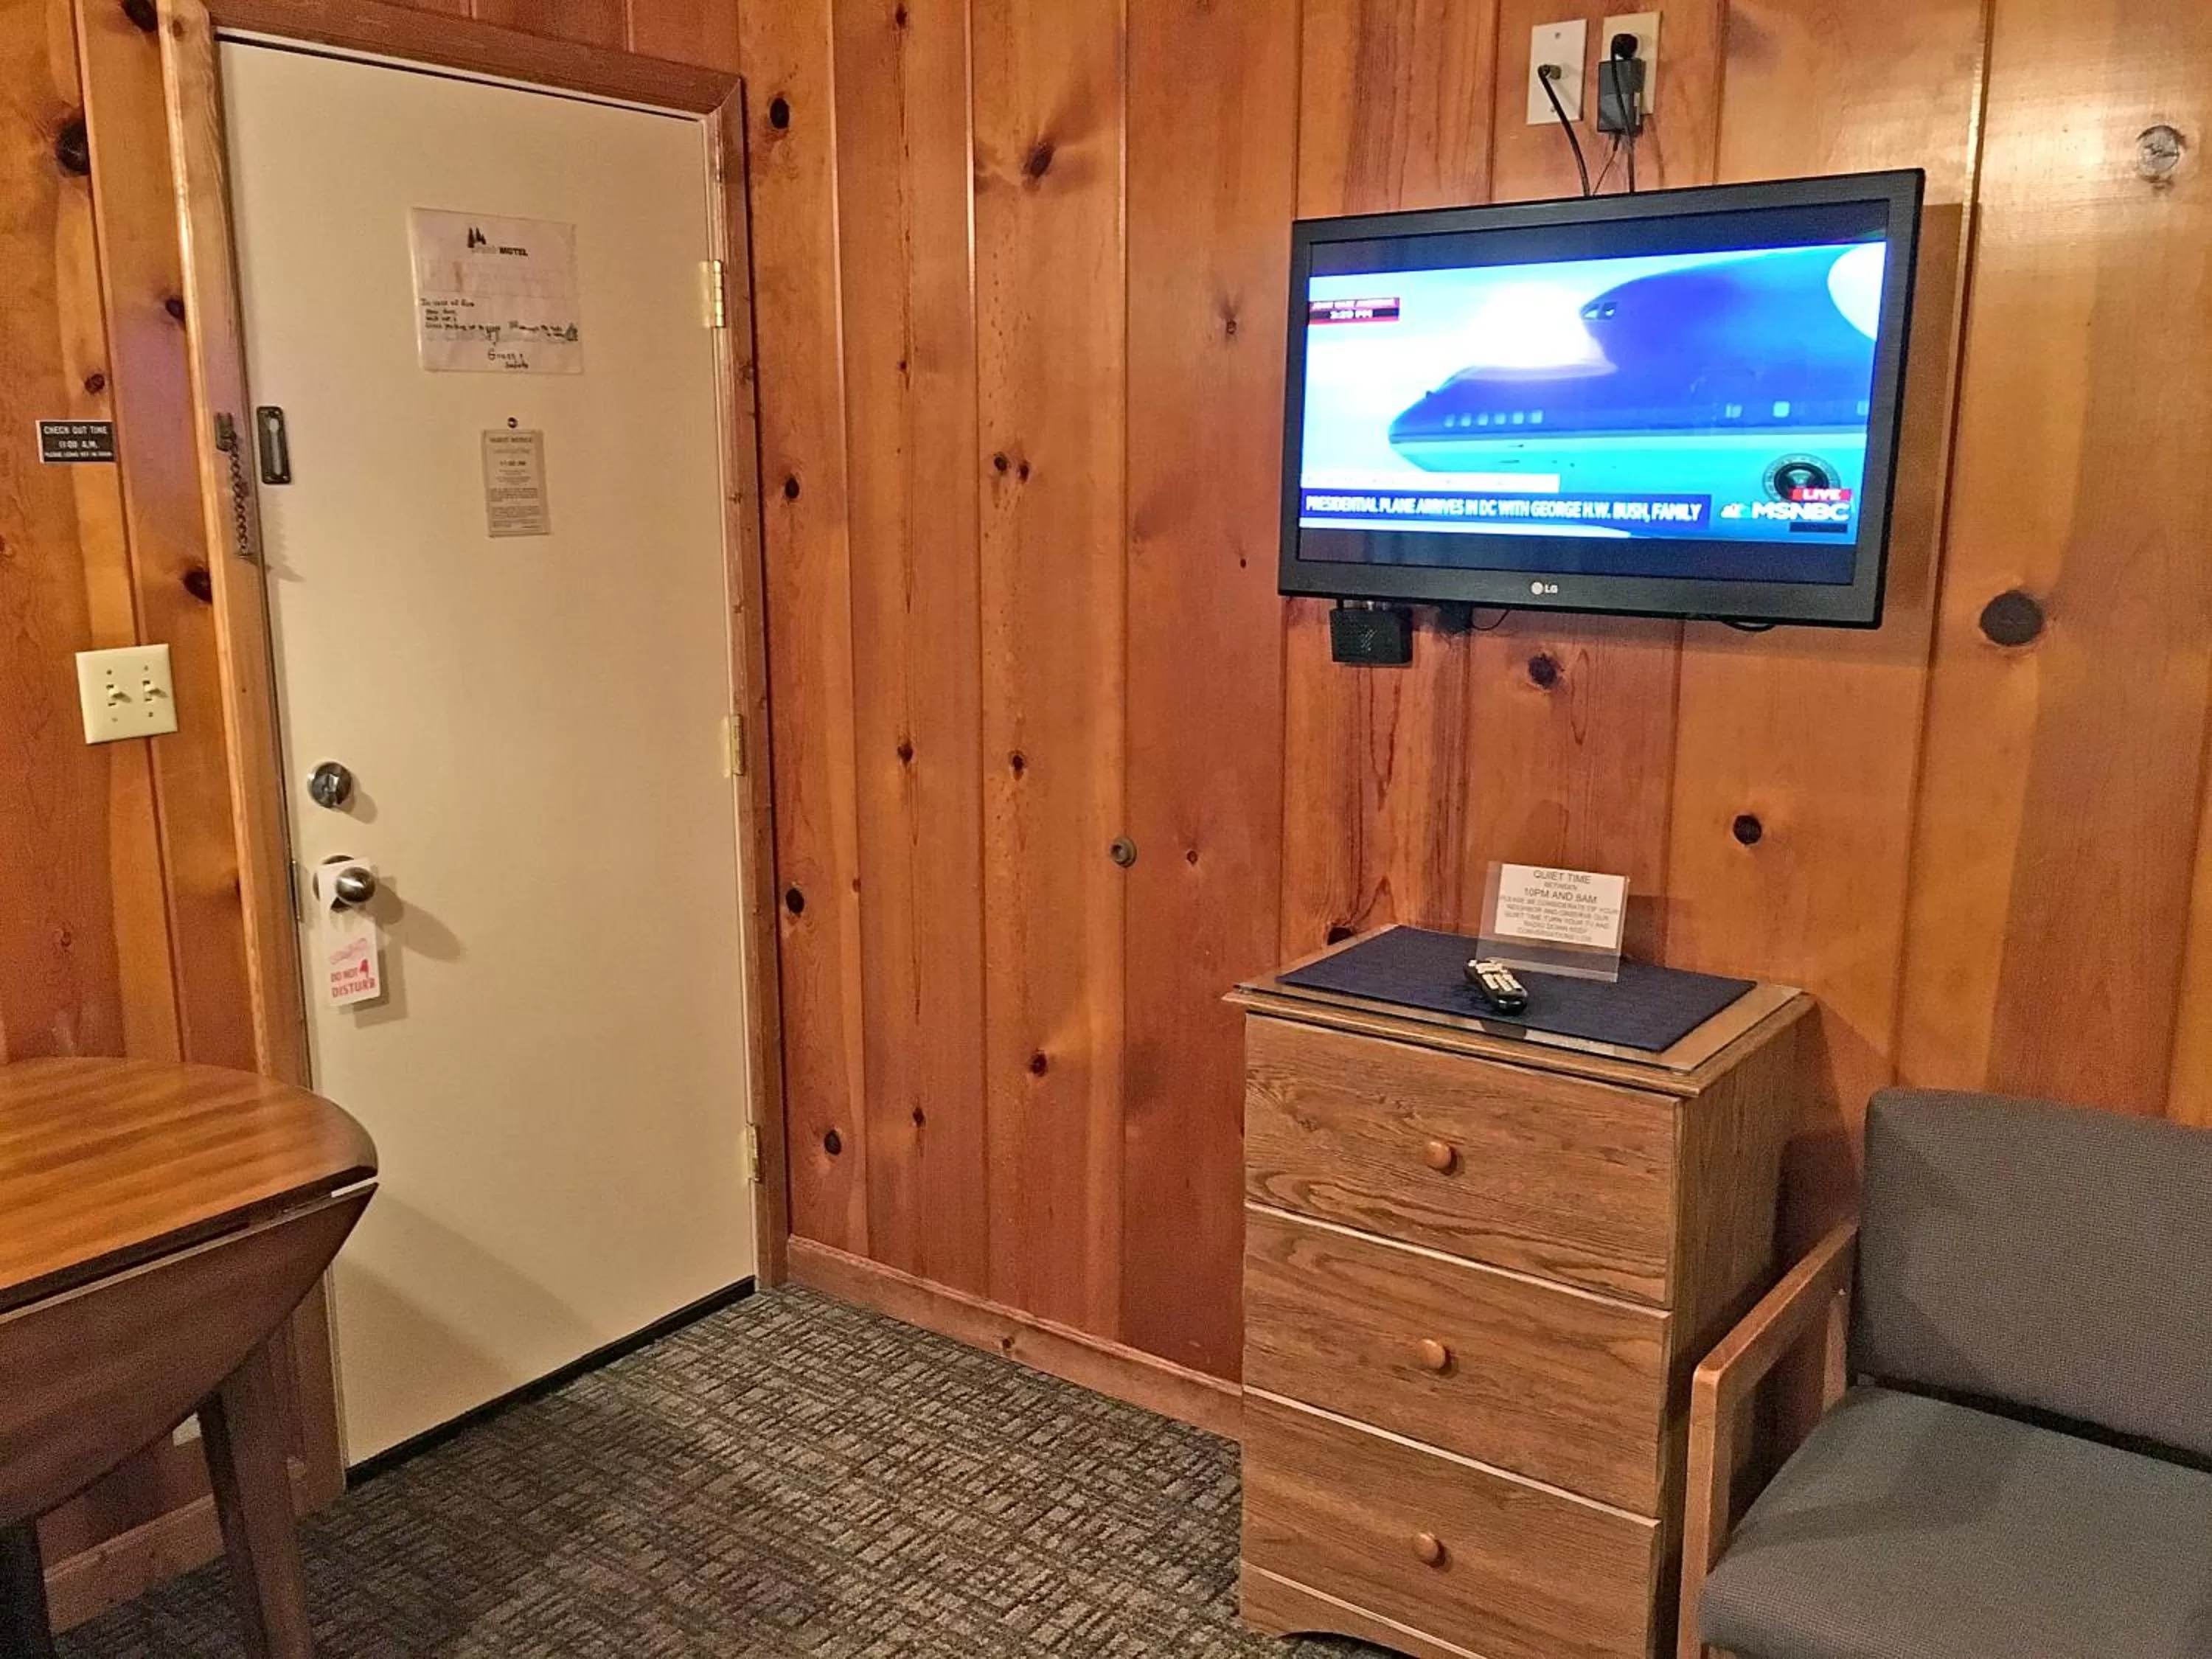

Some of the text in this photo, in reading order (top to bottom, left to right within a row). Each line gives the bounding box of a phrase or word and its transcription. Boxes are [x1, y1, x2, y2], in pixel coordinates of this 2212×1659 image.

[44, 425, 107, 434] CHECK OUT TIME
[1802, 489, 1842, 501] LIVE
[1306, 495, 1703, 522] PRESIDENTIAL PLANE ARRIVES IN DC WITH GEORGE H.W. BUSH, FAMILY
[1752, 502, 1850, 521] MSNBC
[1545, 584, 1558, 594] LG
[1534, 869, 1592, 884] QUIET TIME
[1524, 887, 1549, 898] 10PM
[1552, 890, 1573, 901] AND
[330, 967, 358, 983] DO NOT
[332, 978, 376, 998] DISTURB
